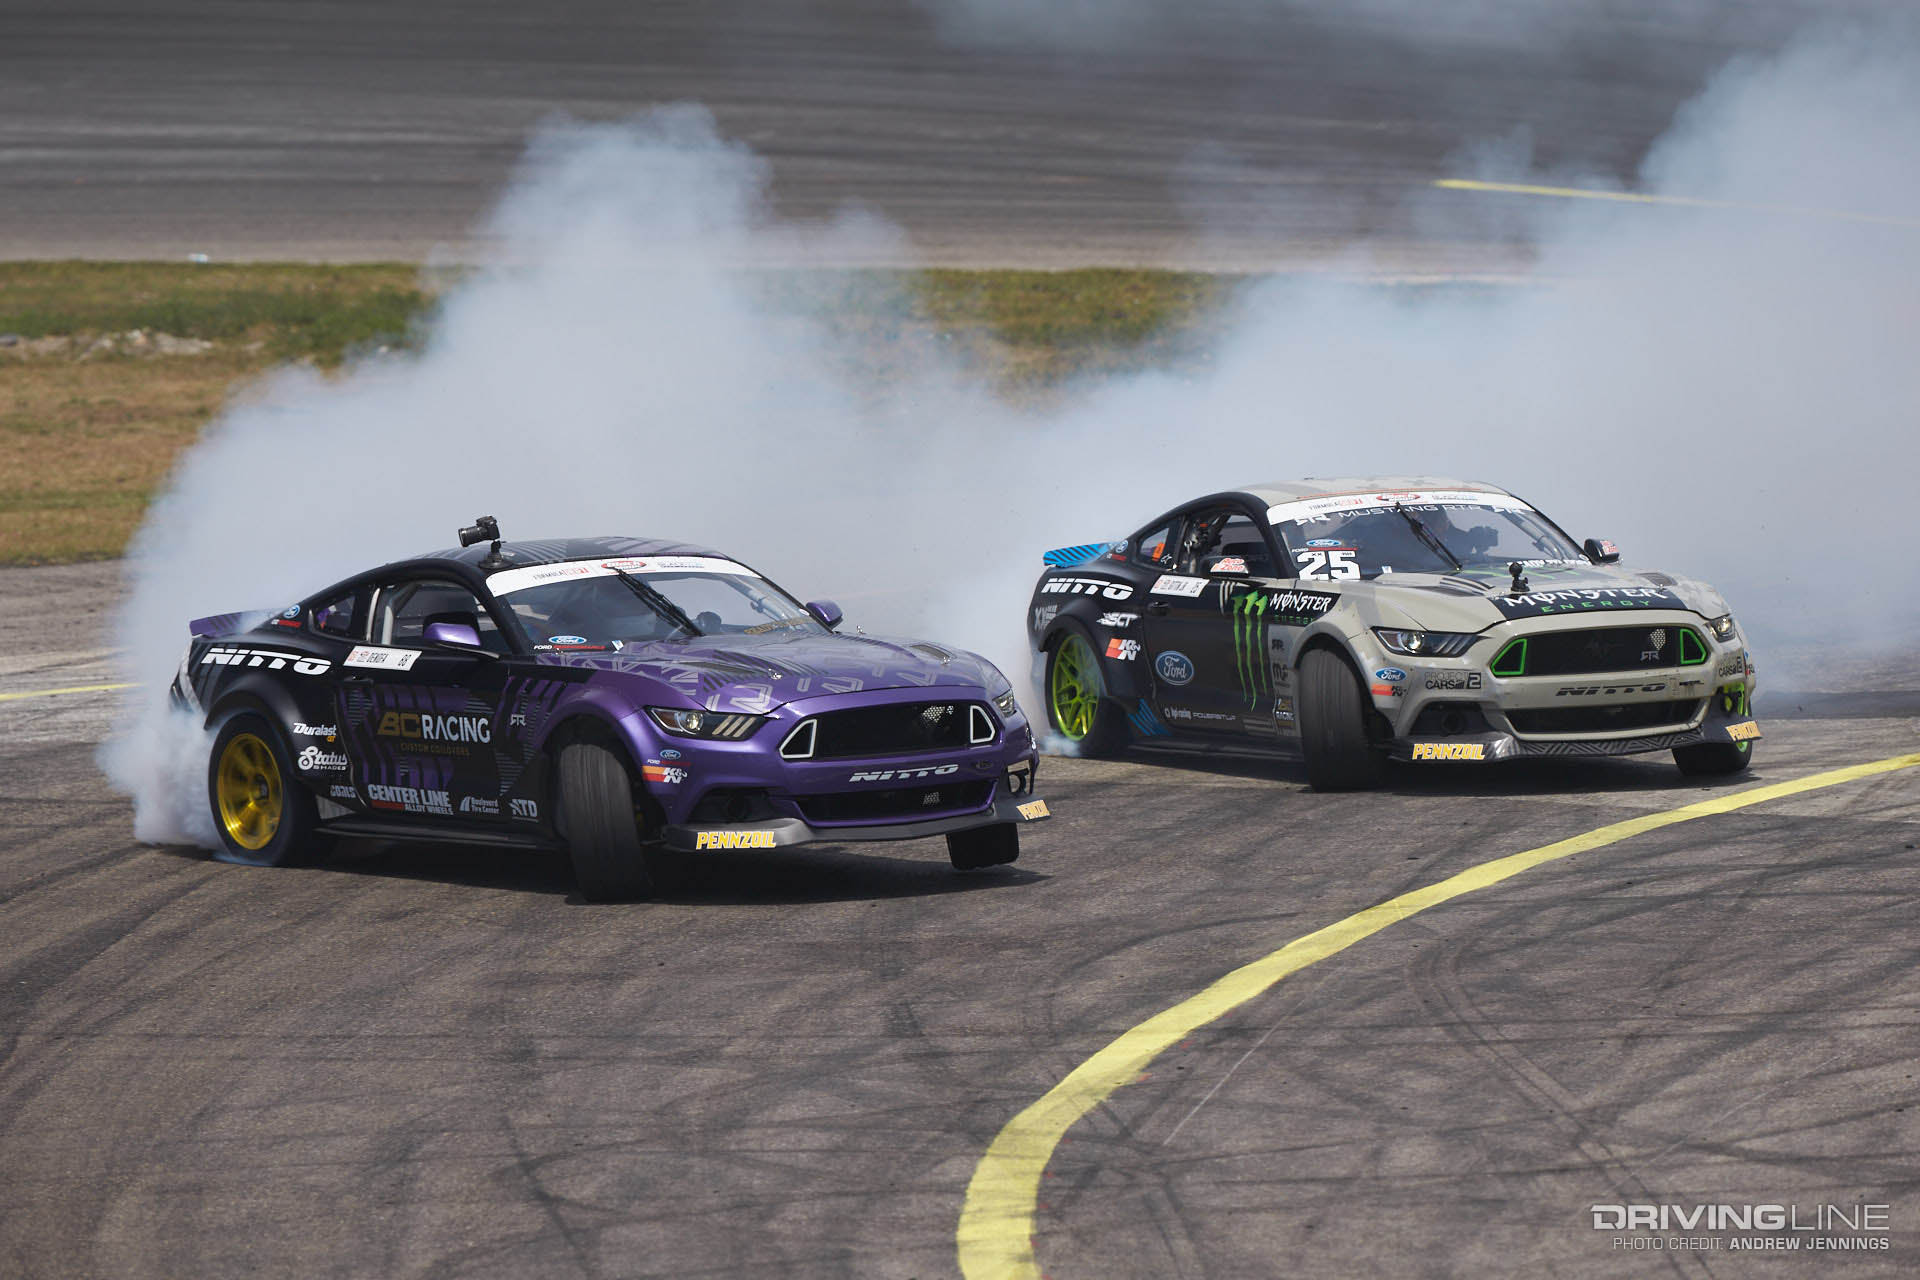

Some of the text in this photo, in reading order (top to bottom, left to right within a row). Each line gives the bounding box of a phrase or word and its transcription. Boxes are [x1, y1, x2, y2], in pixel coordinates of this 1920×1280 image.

[1338, 504, 1439, 518] MUSTANG
[1297, 550, 1361, 581] 25
[1041, 578, 1134, 600] NITTO
[1541, 599, 1650, 613] ENERGY
[201, 647, 331, 675] NITTO
[1424, 671, 1467, 681] PROJECT
[1425, 680, 1455, 690] CARS
[1555, 682, 1666, 698] NITTO
[293, 722, 337, 736] Duralast
[421, 714, 491, 744] RACING
[298, 746, 348, 770] Status
[1411, 743, 1486, 761] PENNZOIL
[663, 767, 688, 784] K&N
[849, 764, 960, 782] NITTO
[367, 783, 420, 805] CENTER
[420, 789, 452, 808] LINE
[696, 831, 777, 850] PENNZOIL
